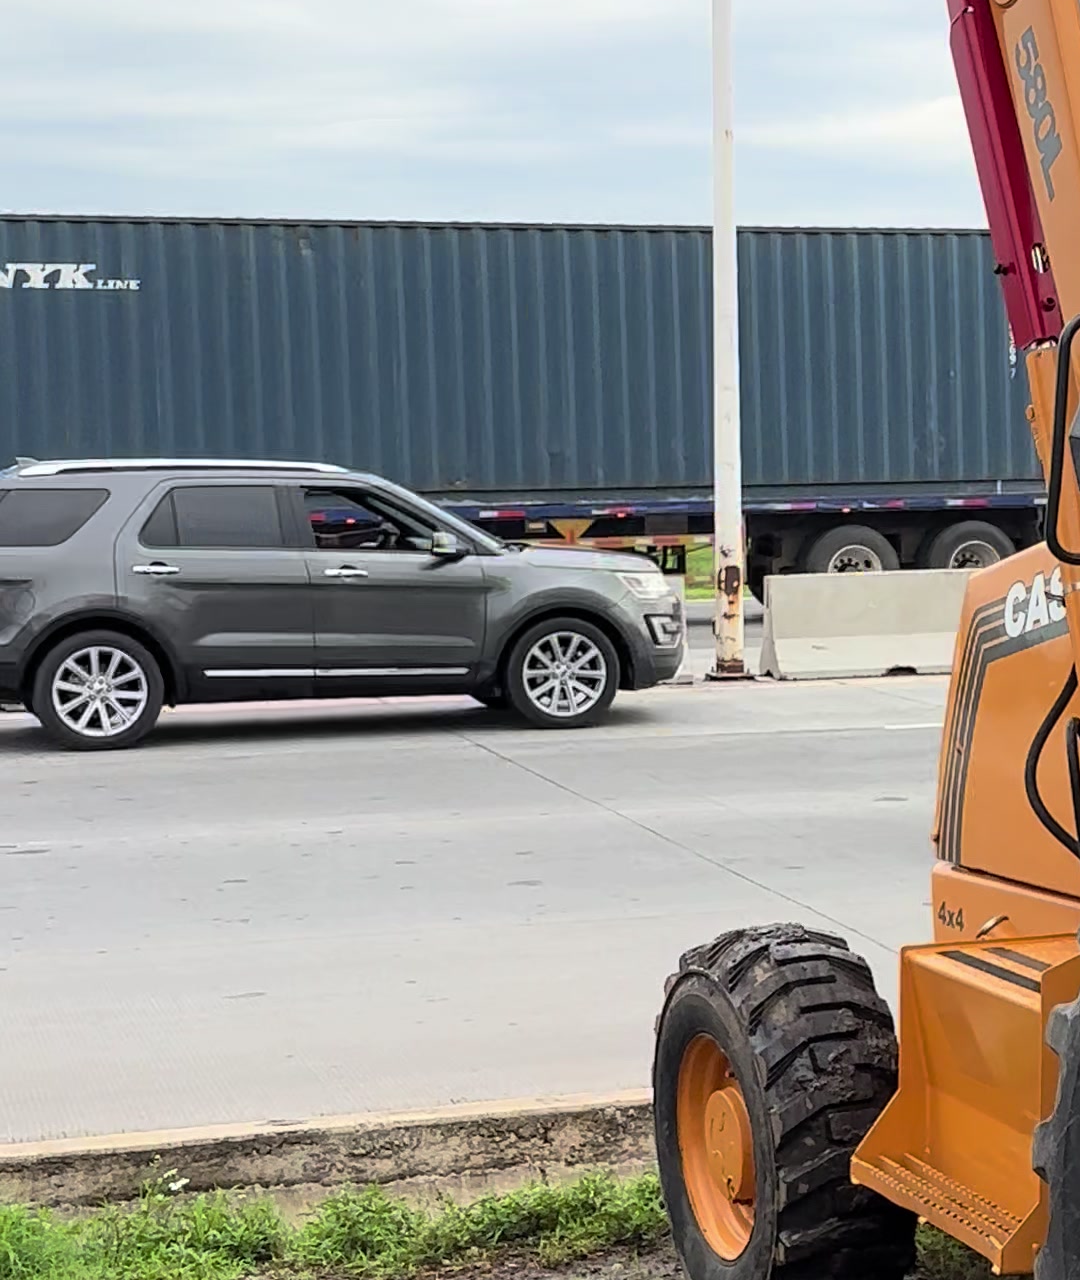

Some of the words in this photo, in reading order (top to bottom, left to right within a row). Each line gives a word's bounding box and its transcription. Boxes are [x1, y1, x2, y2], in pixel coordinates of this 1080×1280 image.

[1015, 26, 1062, 202] 580L
[97, 279, 140, 290] LINE
[1004, 566, 1067, 638] CAS
[938, 901, 964, 932] 4x4
